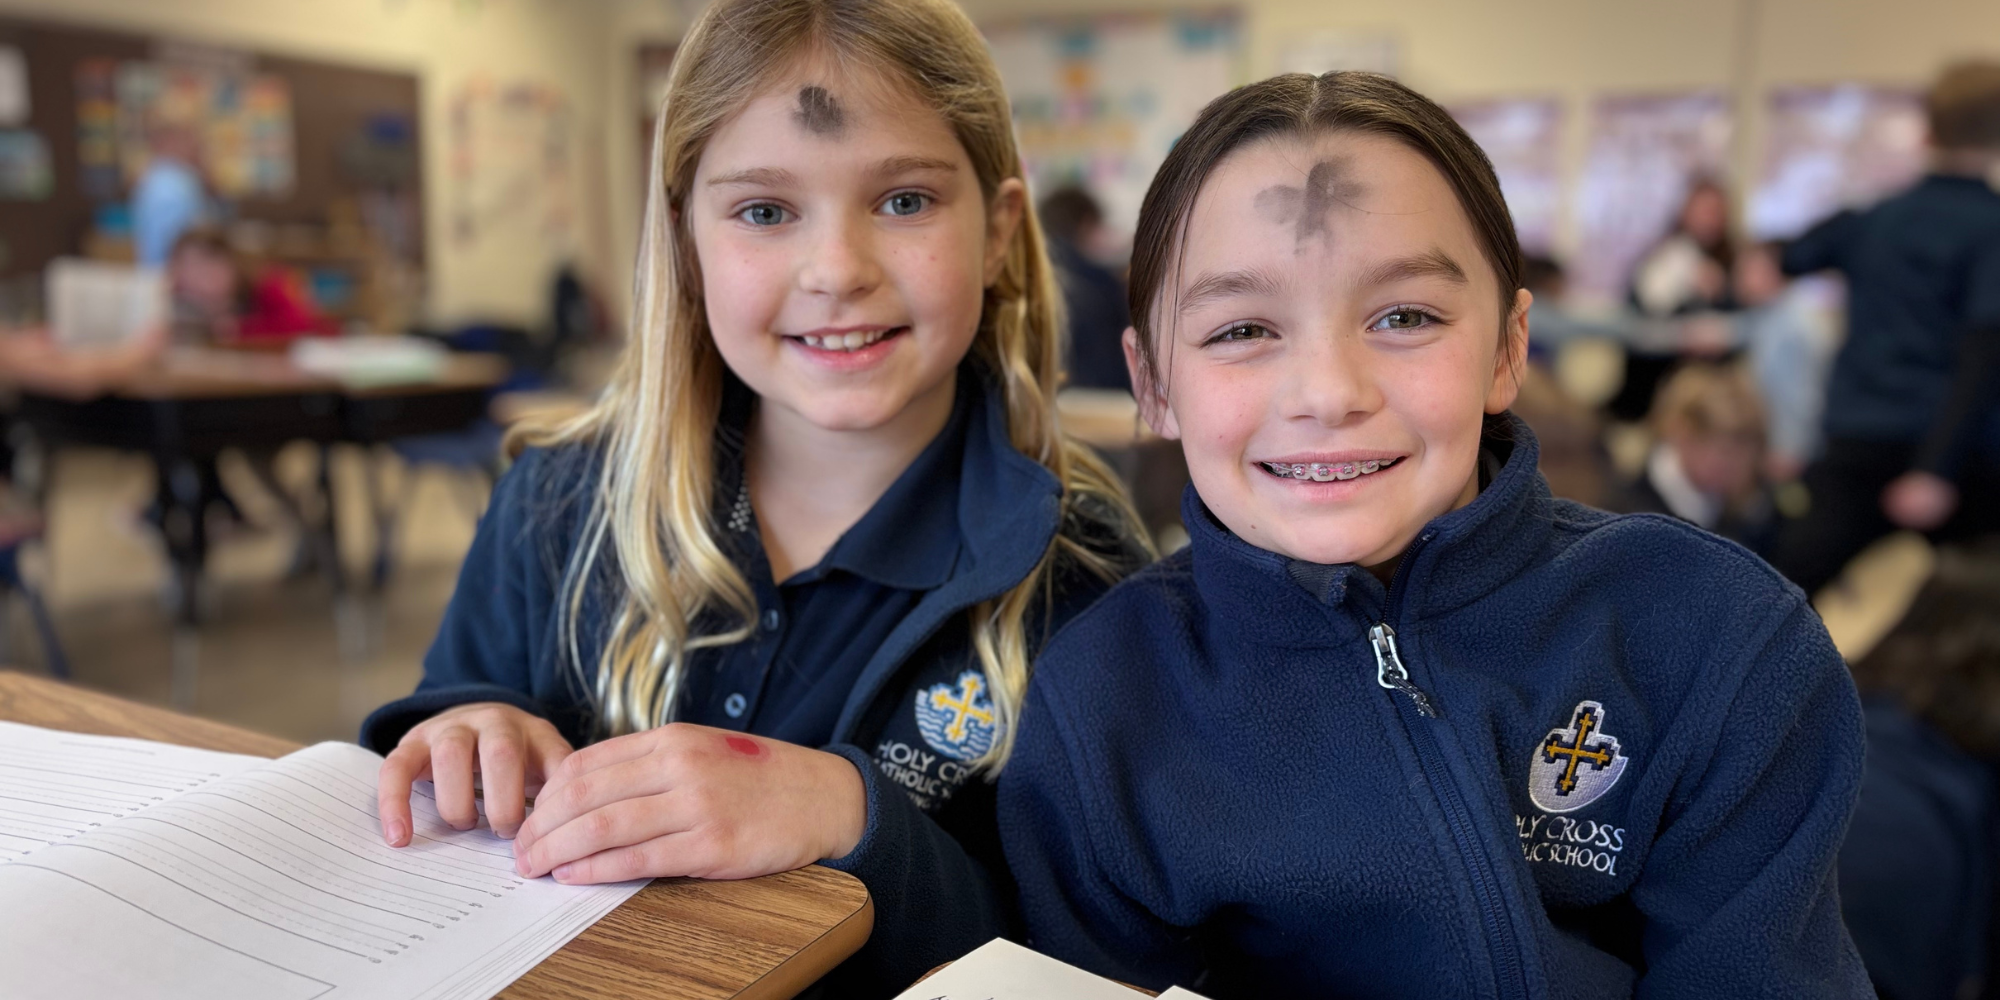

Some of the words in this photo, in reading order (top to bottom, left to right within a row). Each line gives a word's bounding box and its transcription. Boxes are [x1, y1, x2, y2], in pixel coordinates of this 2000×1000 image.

[1515, 814, 1547, 838] LY
[1546, 816, 1625, 851] CROSS
[1548, 844, 1616, 876] SCHOOL
